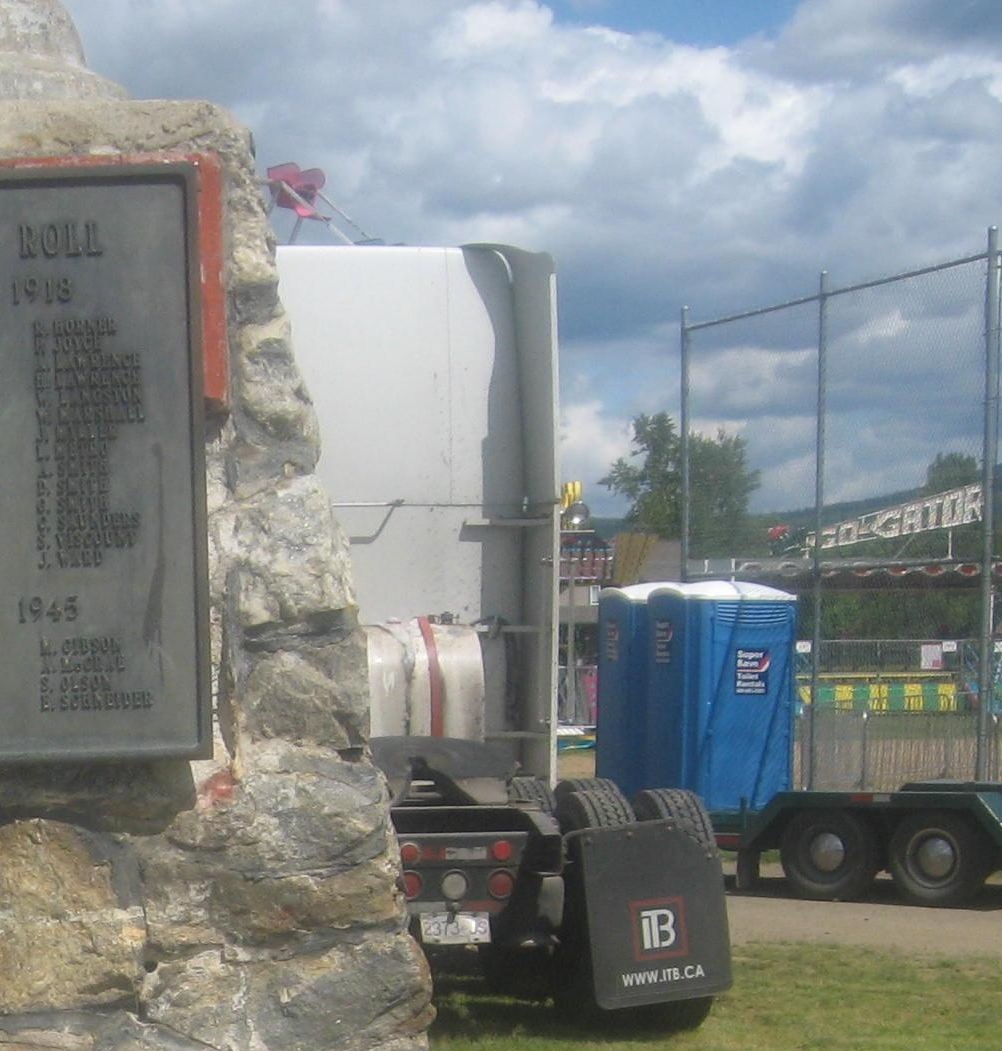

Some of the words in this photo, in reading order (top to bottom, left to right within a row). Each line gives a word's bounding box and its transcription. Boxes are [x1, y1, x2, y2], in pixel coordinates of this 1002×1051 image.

[19, 221, 103, 260] ROLL
[11, 277, 73, 306] 1918
[17, 595, 79, 624] 1945
[737, 672, 759, 680] Toilet
[622, 964, 706, 988] WWW.ITB.CA
